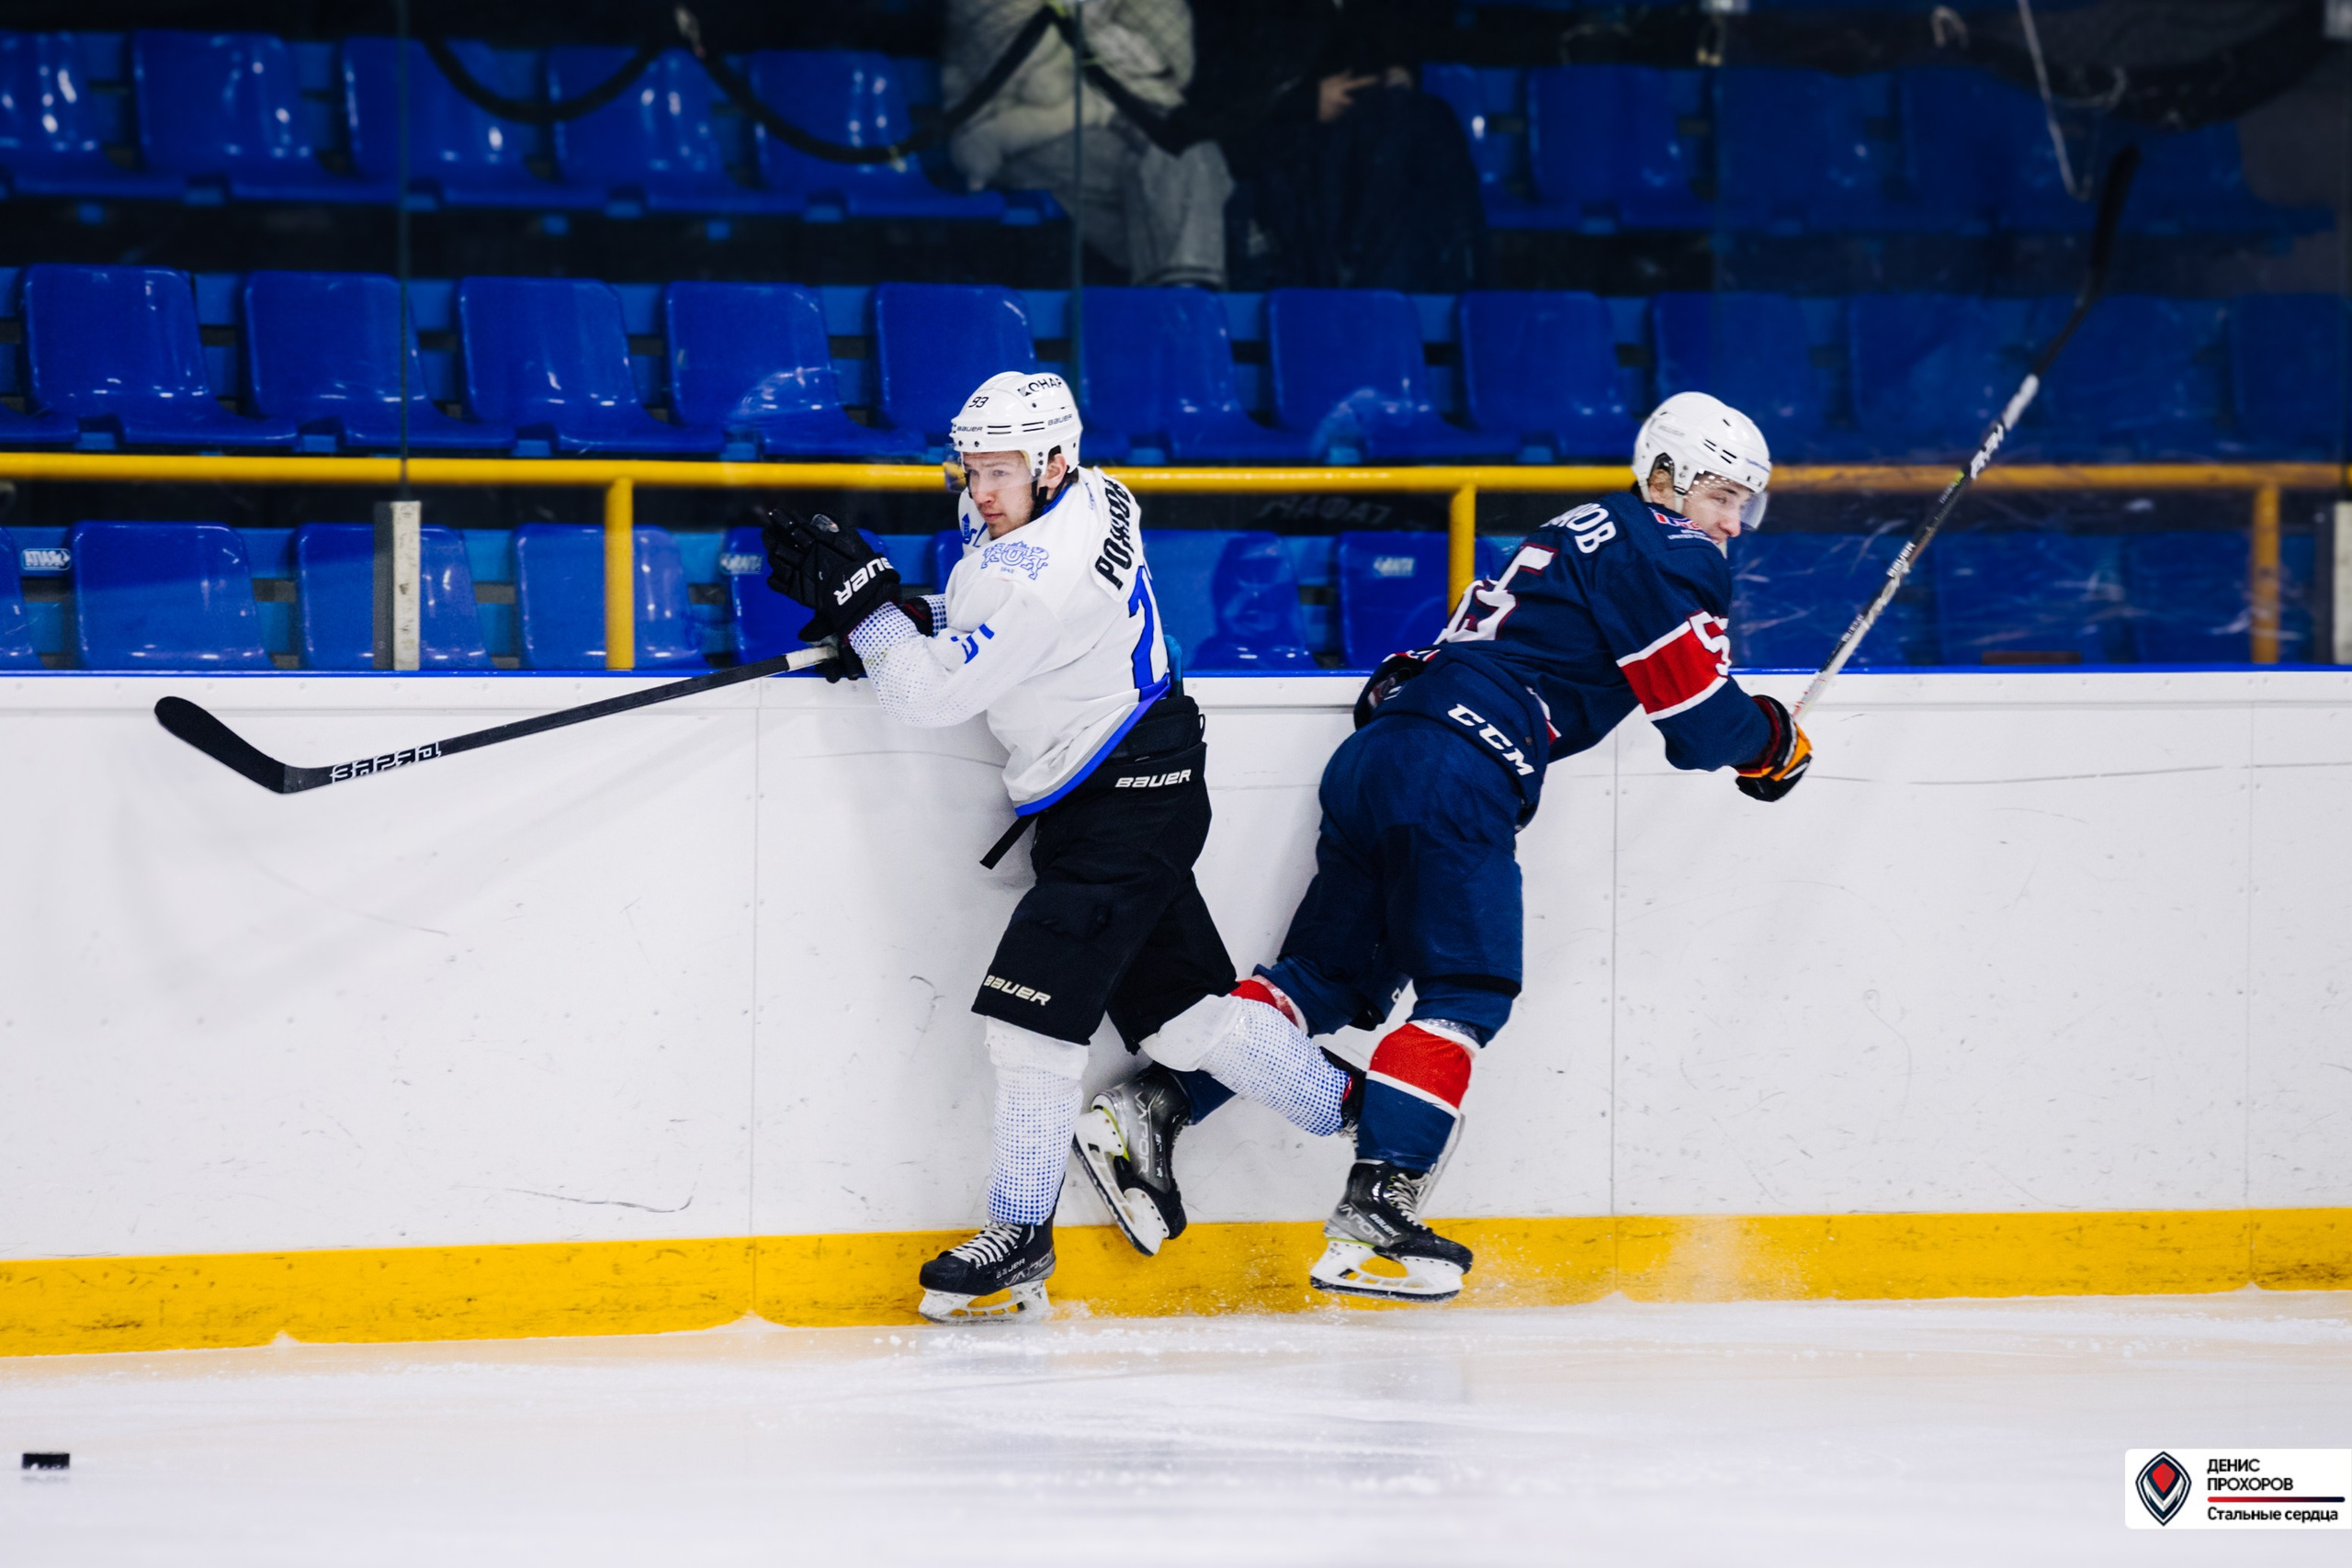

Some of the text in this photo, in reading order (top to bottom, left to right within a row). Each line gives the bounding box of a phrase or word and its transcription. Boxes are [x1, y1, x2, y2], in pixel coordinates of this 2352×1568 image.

[968, 396, 989, 409] 93
[1047, 413, 1073, 426] BAUER
[1447, 703, 1535, 776] CCM
[1114, 769, 1192, 788] BAUER
[983, 975, 1052, 1006] BAUER
[1135, 1091, 1150, 1175] VAPOR
